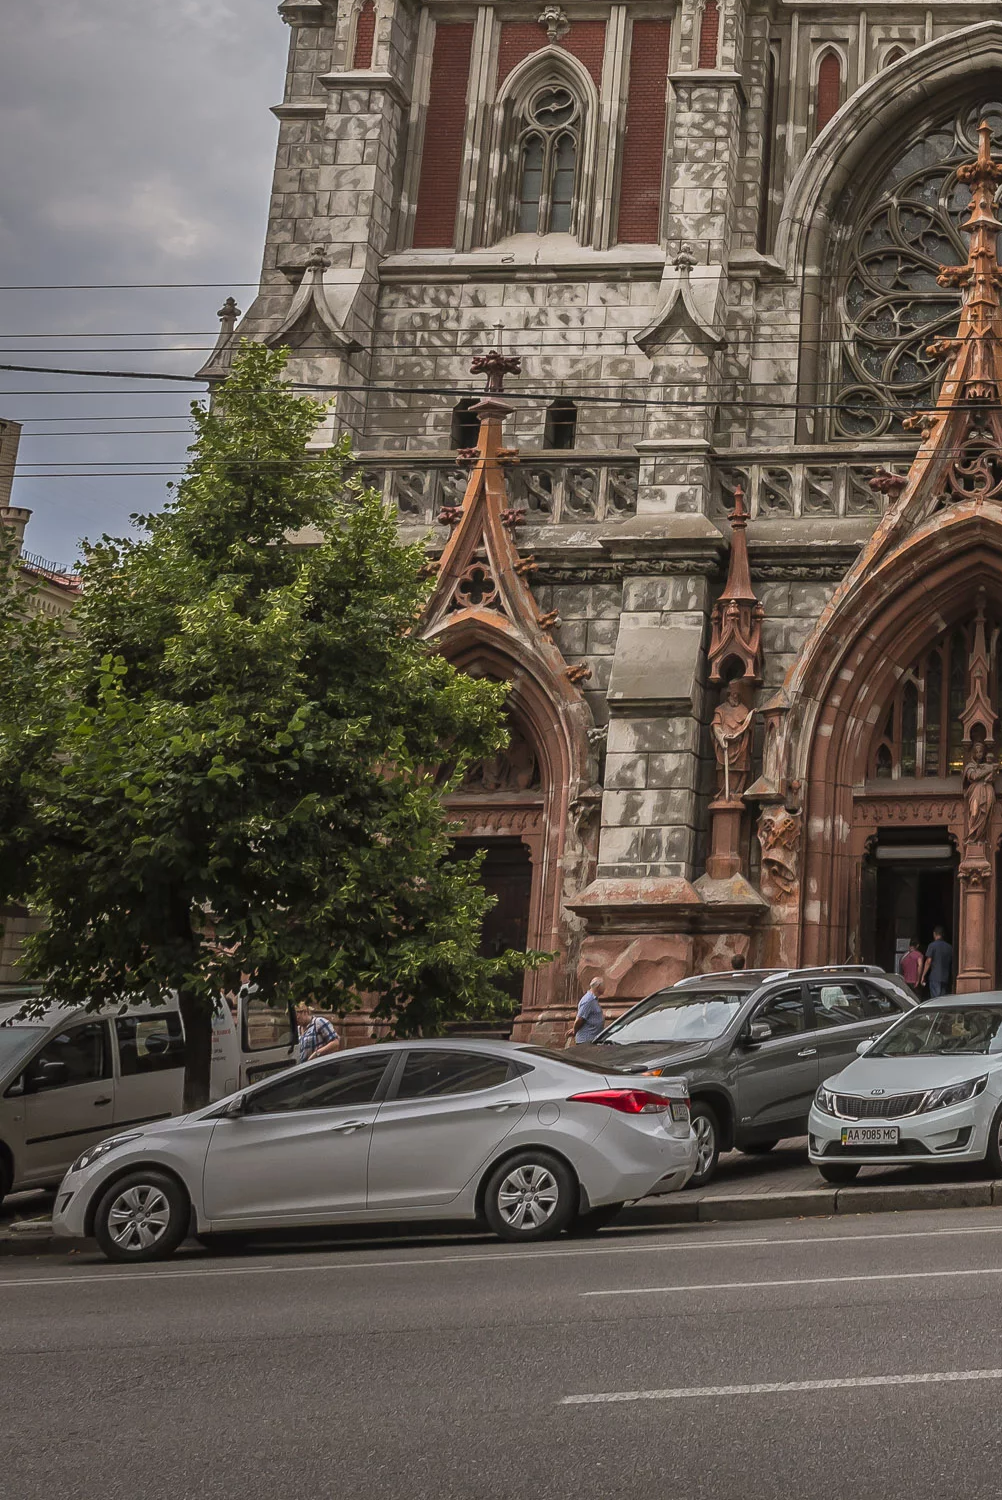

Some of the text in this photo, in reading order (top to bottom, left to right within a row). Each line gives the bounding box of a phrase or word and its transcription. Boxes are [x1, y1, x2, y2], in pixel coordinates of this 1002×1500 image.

[848, 1129, 896, 1140] AA 9085 MC
